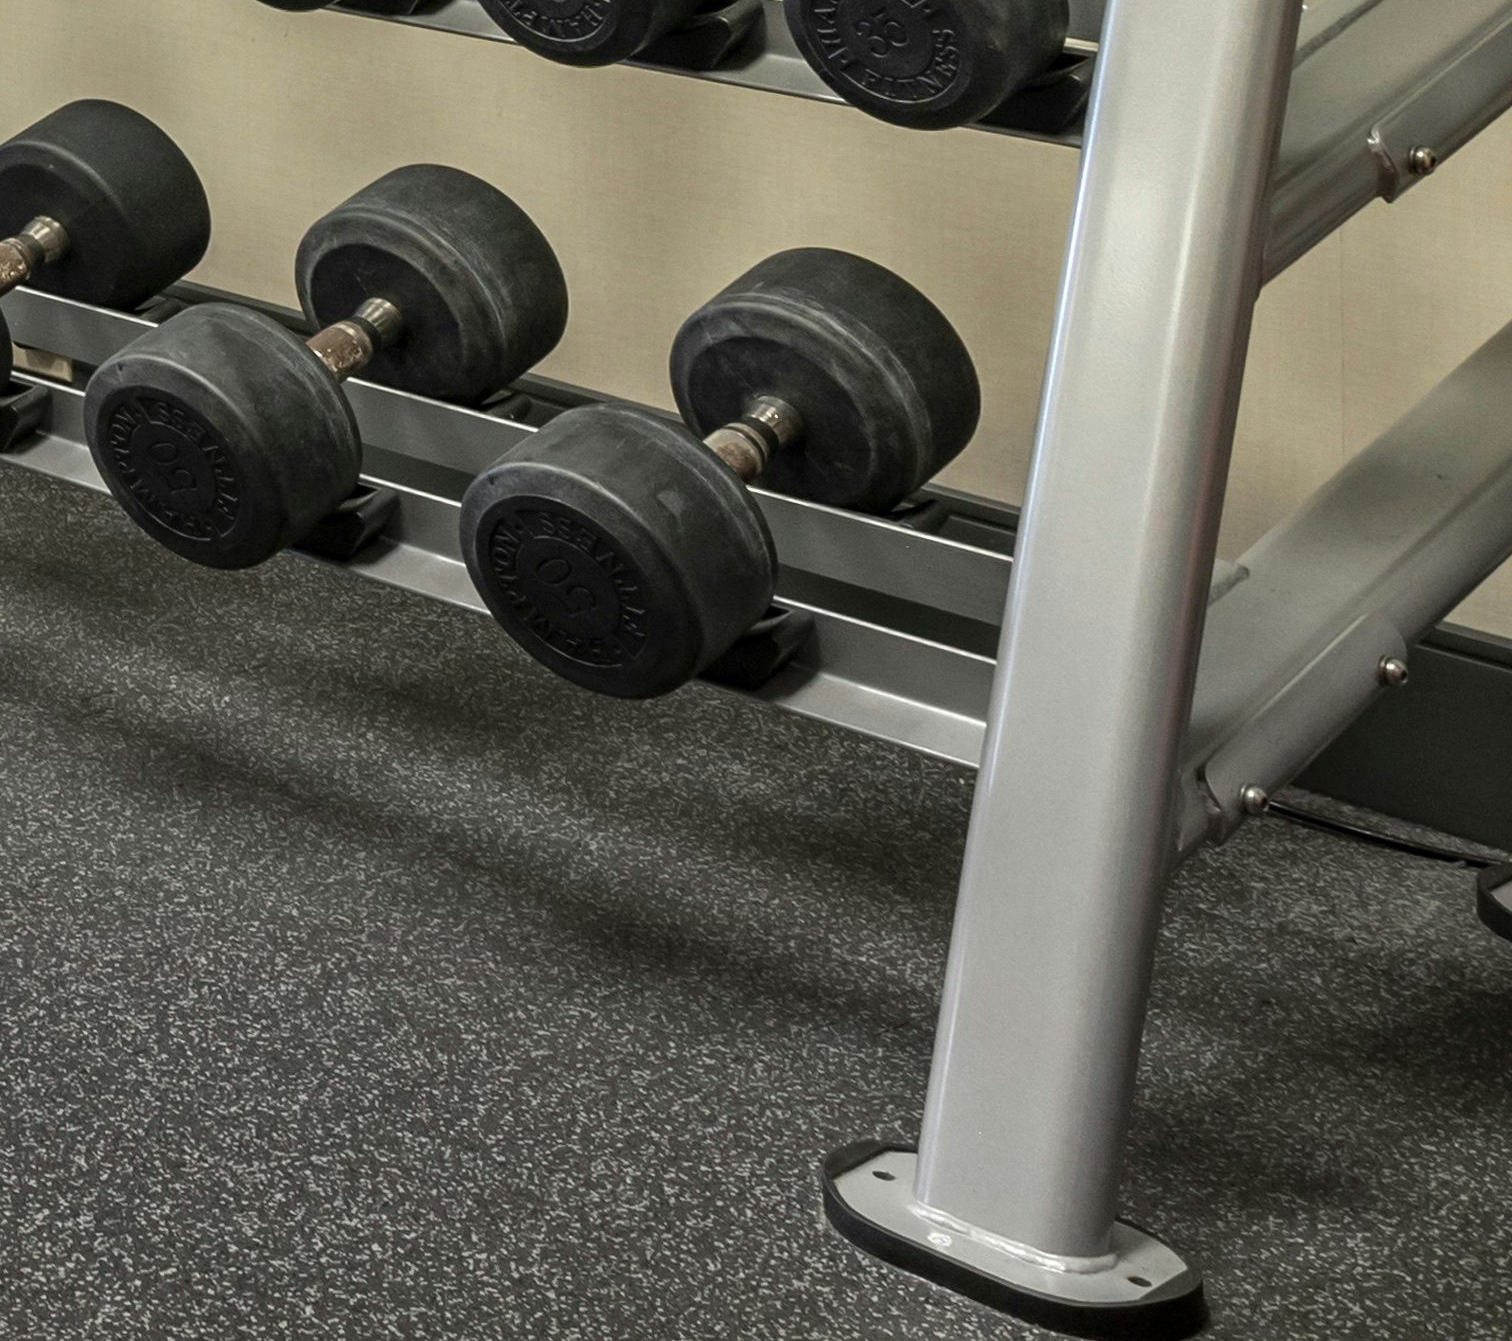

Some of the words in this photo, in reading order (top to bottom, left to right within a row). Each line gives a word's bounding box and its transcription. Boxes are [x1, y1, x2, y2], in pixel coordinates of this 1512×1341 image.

[853, 5, 911, 59] 35
[860, 26, 960, 102] FITNESS
[147, 440, 198, 497] 50
[489, 528, 624, 663] HAMPTON
[534, 555, 600, 620] 50
[536, 518, 646, 643] FITNESS
